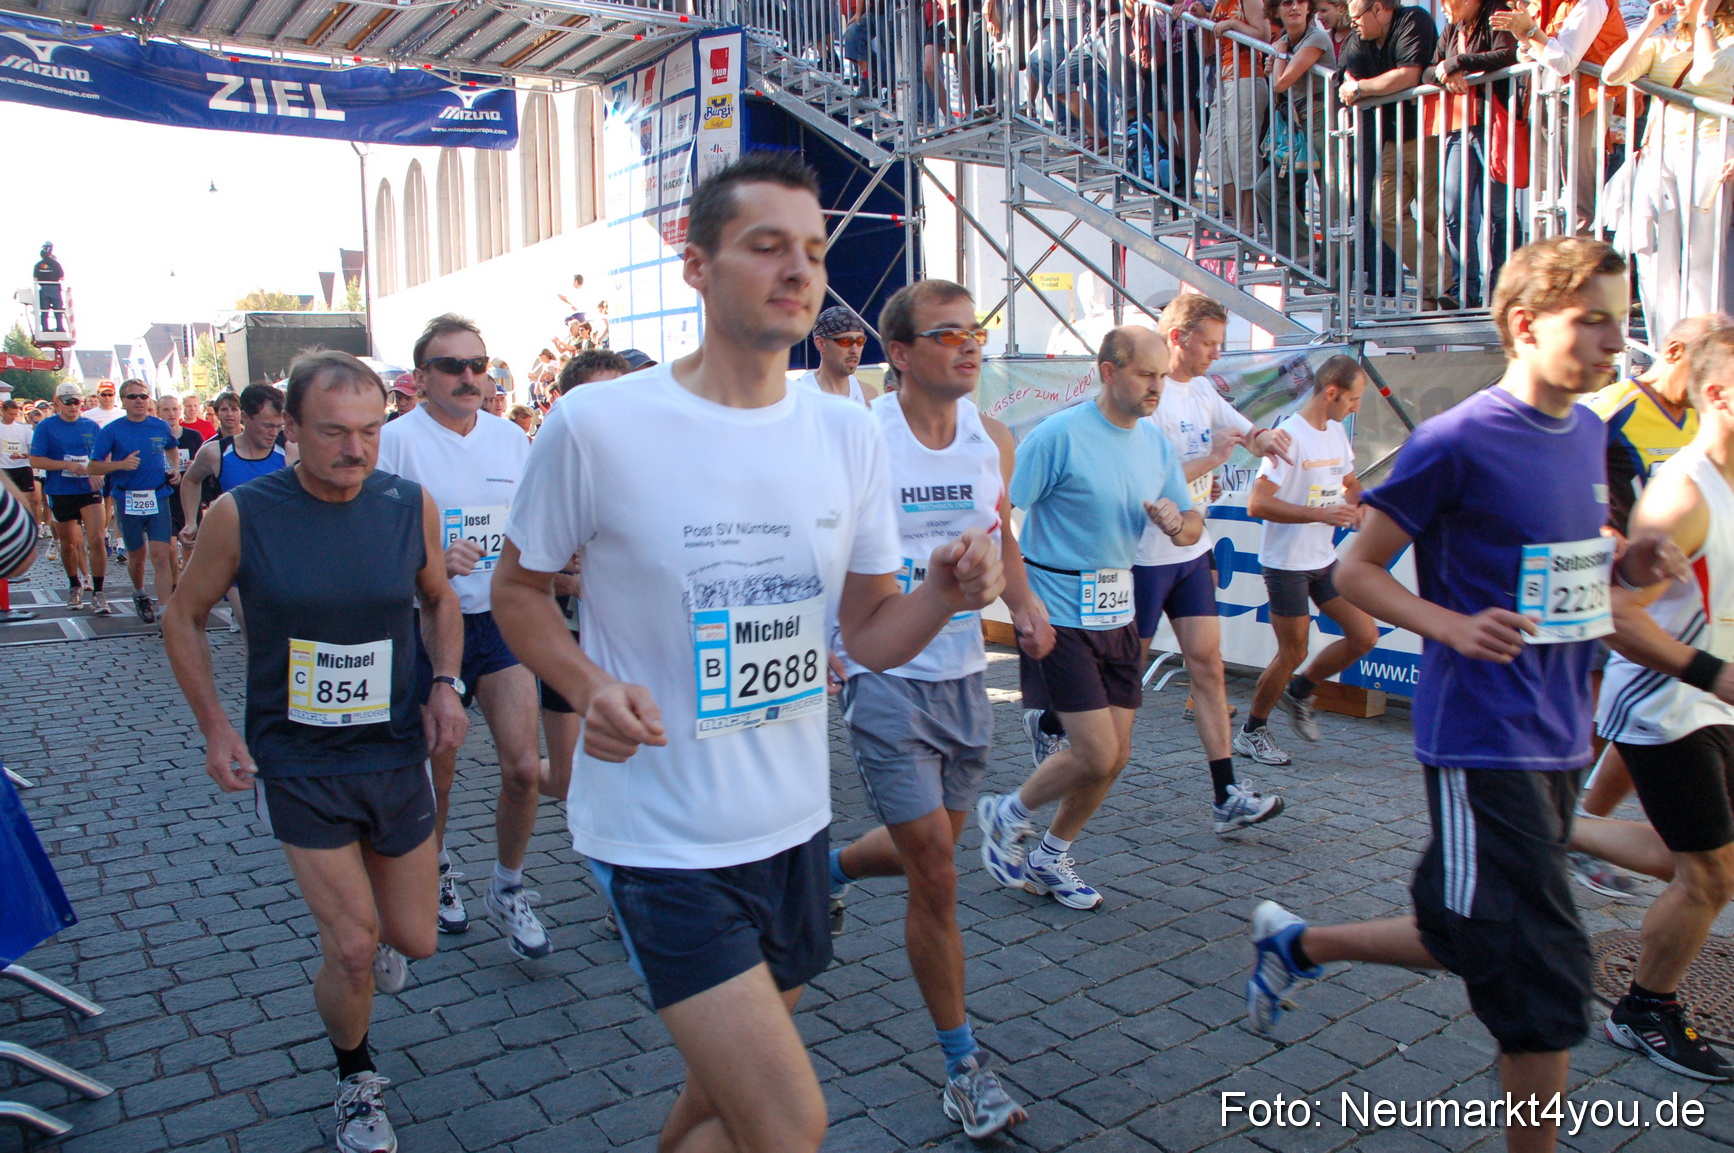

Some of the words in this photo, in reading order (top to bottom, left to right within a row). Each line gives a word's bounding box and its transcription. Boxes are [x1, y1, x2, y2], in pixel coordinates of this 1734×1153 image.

[0, 76, 100, 100] ww.mizunoeurope.com
[206, 72, 345, 121] ZIEL
[438, 105, 501, 121] MIZUNO
[1034, 389, 1059, 402] zum
[1065, 367, 1096, 402] Leben
[901, 484, 974, 503] HUBER
[134, 500, 155, 509] 2269
[464, 513, 490, 527] Josef
[683, 524, 713, 538] Post
[716, 522, 733, 536] SV
[1097, 590, 1128, 609] 2344
[735, 614, 800, 645] Michél
[317, 651, 375, 669] Michael
[706, 658, 721, 678] B
[295, 671, 306, 685] C
[738, 648, 817, 698] 2688
[316, 679, 369, 704] 854
